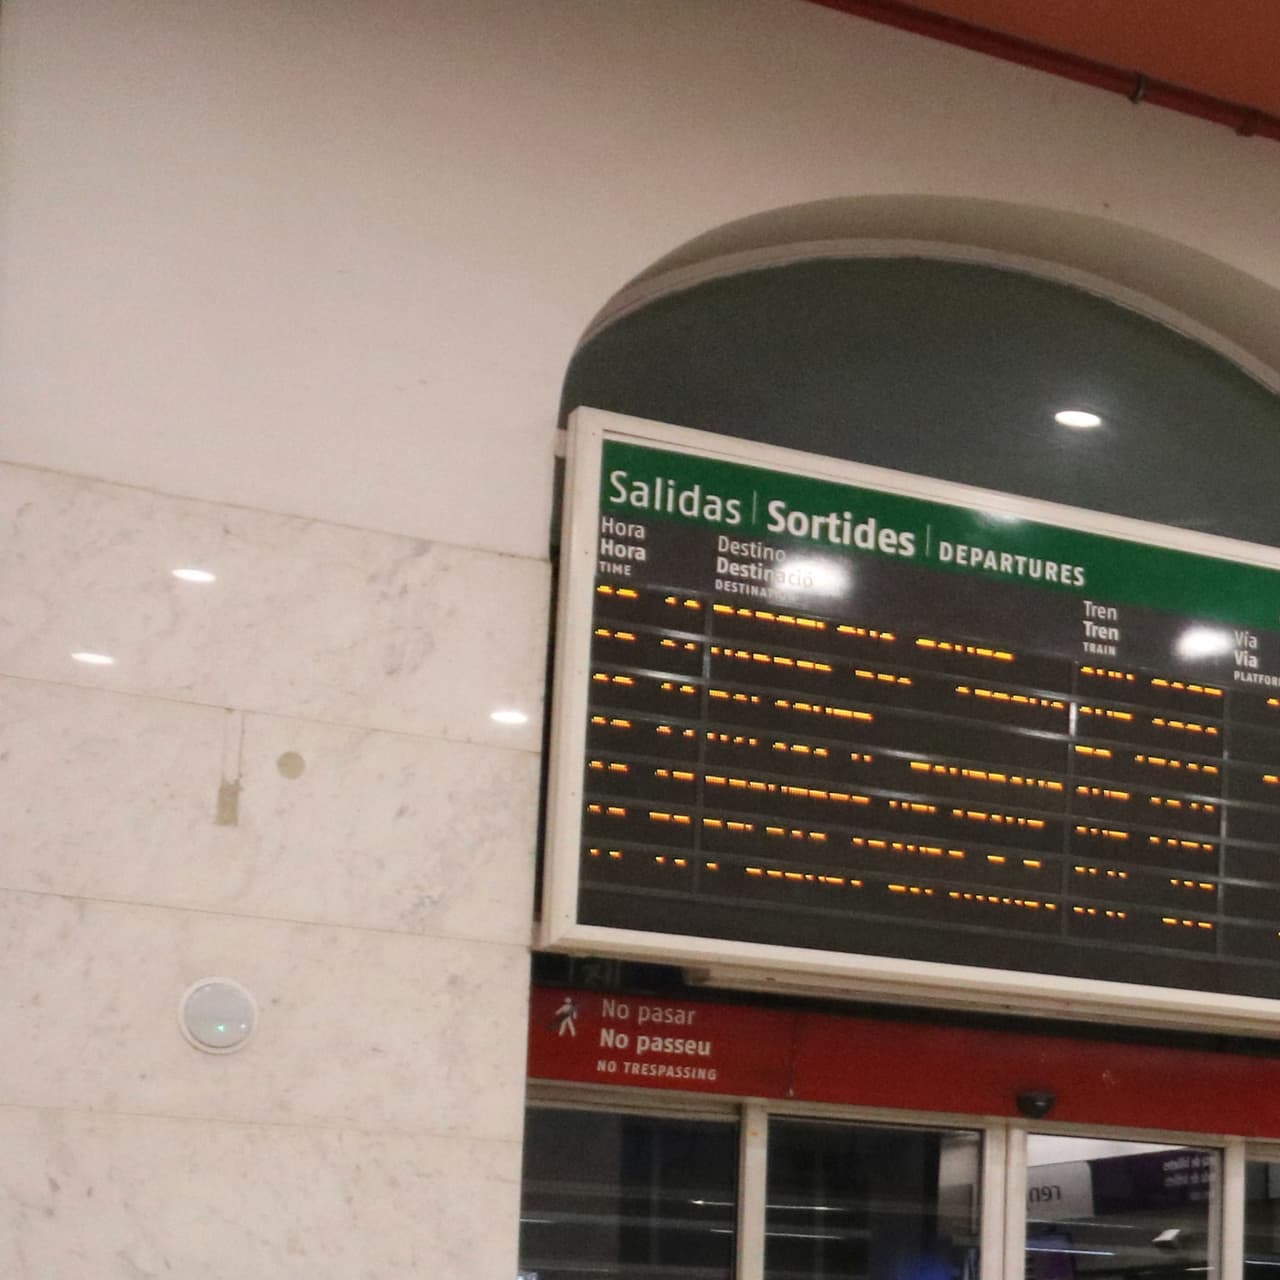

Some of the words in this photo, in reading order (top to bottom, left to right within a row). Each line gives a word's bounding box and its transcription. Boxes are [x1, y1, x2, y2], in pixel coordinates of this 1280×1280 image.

[601, 516, 646, 540] Hora
[608, 470, 742, 525] Salidas
[766, 499, 916, 557] Sortides
[938, 541, 1087, 587] DEPARTURES
[600, 538, 647, 562] Hora
[717, 535, 786, 562] Destino
[599, 560, 632, 577] TIME
[1083, 600, 1118, 621] Tren
[1083, 620, 1119, 641] Tren
[1083, 641, 1117, 656] TRAIN
[1234, 650, 1259, 669] Via
[601, 998, 630, 1020] No
[637, 1005, 697, 1026] pasar
[600, 1028, 630, 1049] No
[636, 1035, 712, 1057] passeu
[596, 1060, 617, 1073] NO
[623, 1062, 718, 1081] TRESPASSING
